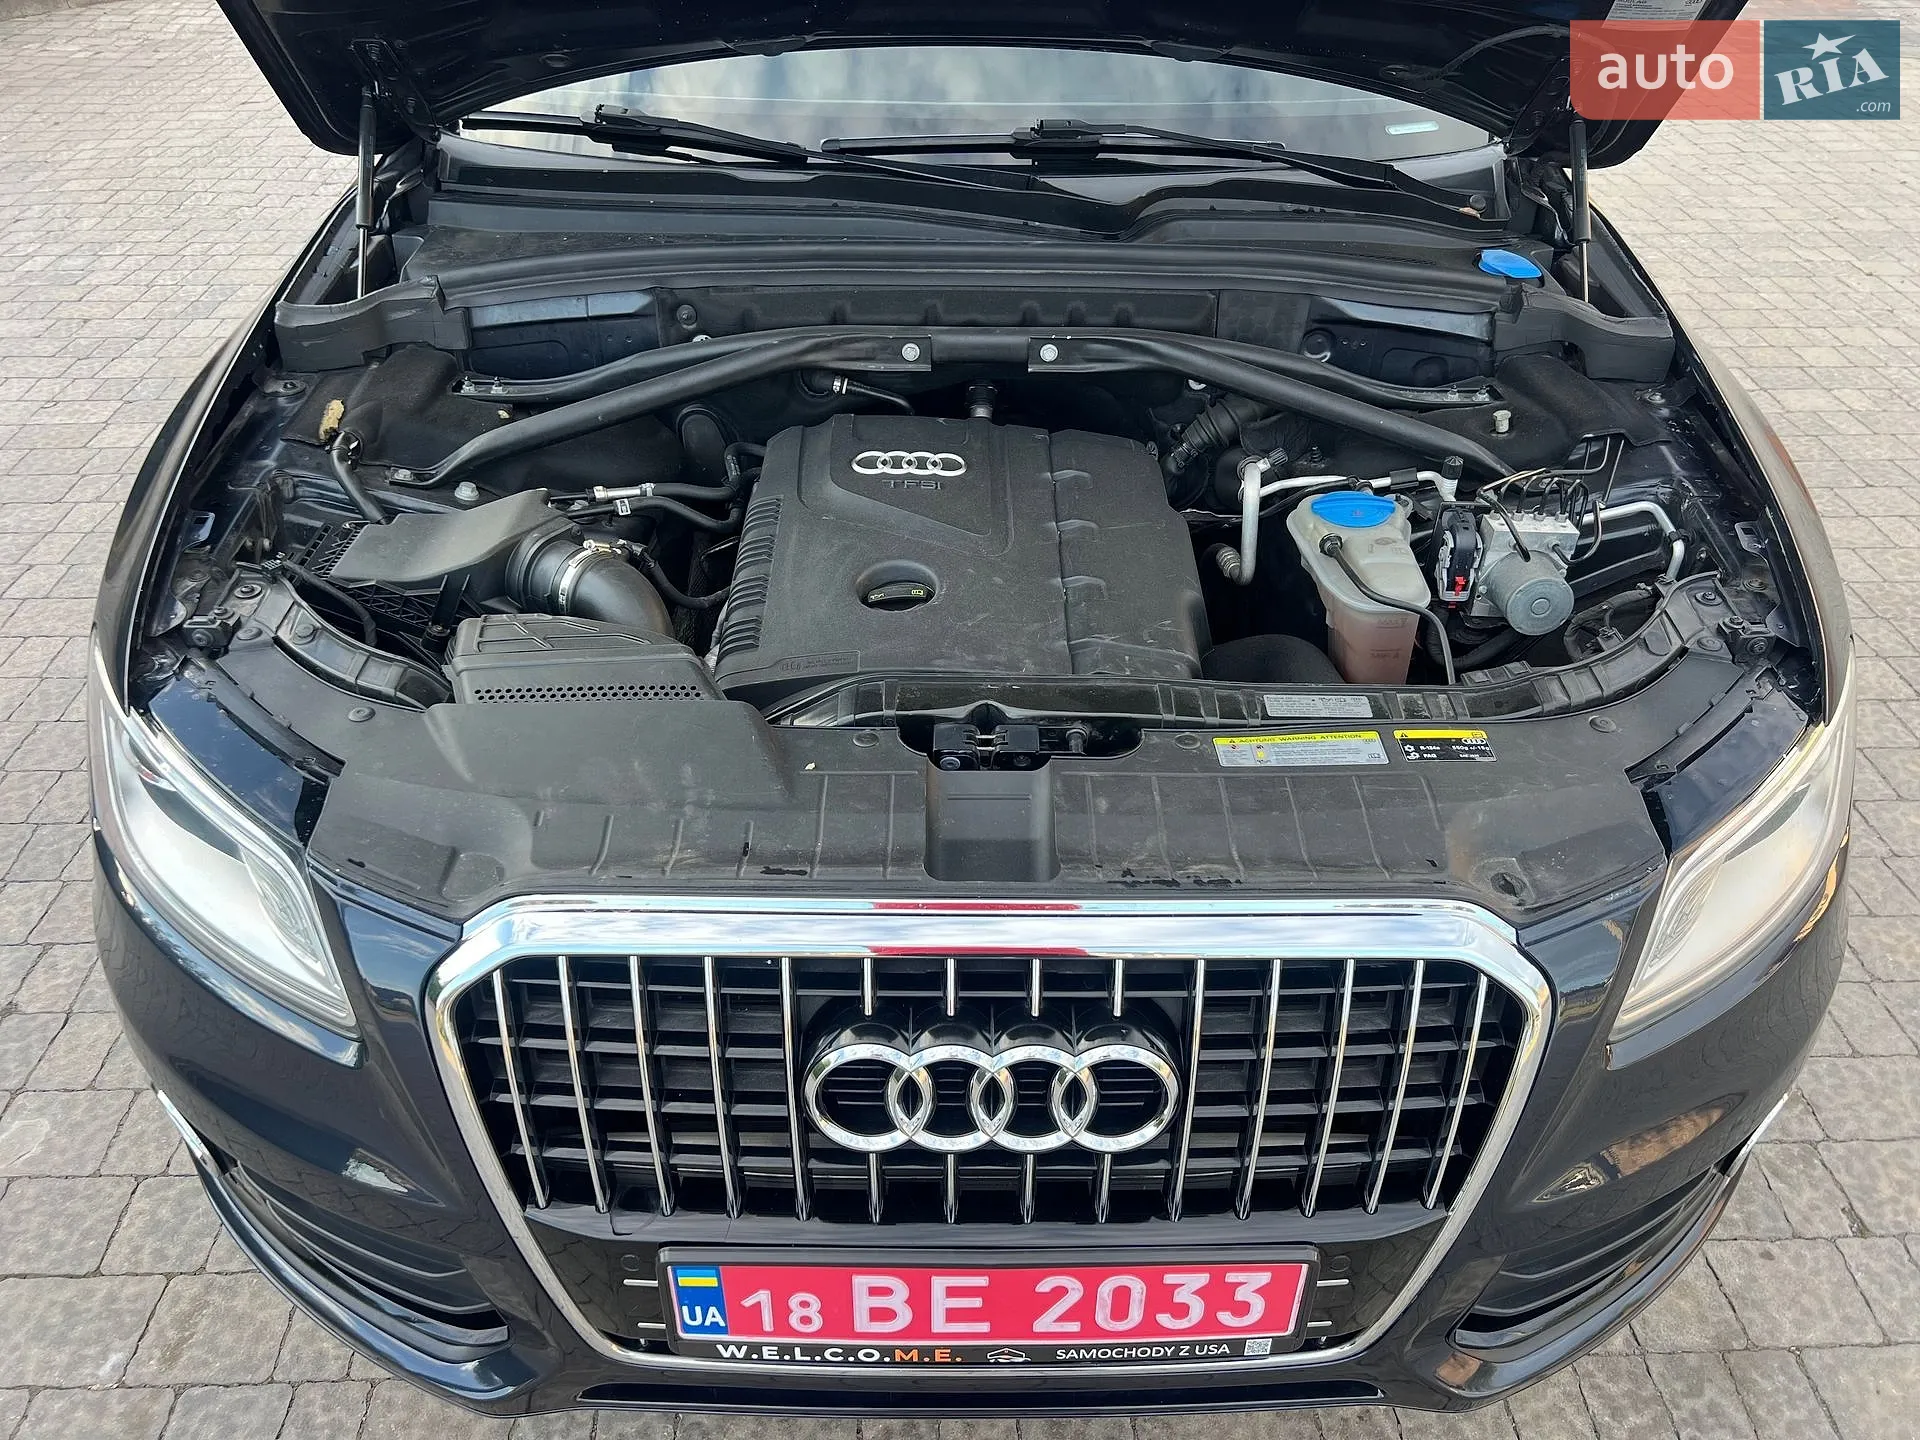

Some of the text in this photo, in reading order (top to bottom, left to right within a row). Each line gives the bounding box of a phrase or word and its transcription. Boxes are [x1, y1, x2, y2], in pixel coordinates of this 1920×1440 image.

[881, 479, 941, 490] TFSI
[740, 1271, 1272, 1334] 18 BE 2033
[681, 1305, 726, 1327] UA
[716, 1343, 1231, 1363] W.E.L.C.O.M.E. SAMOCHODY Z USA
